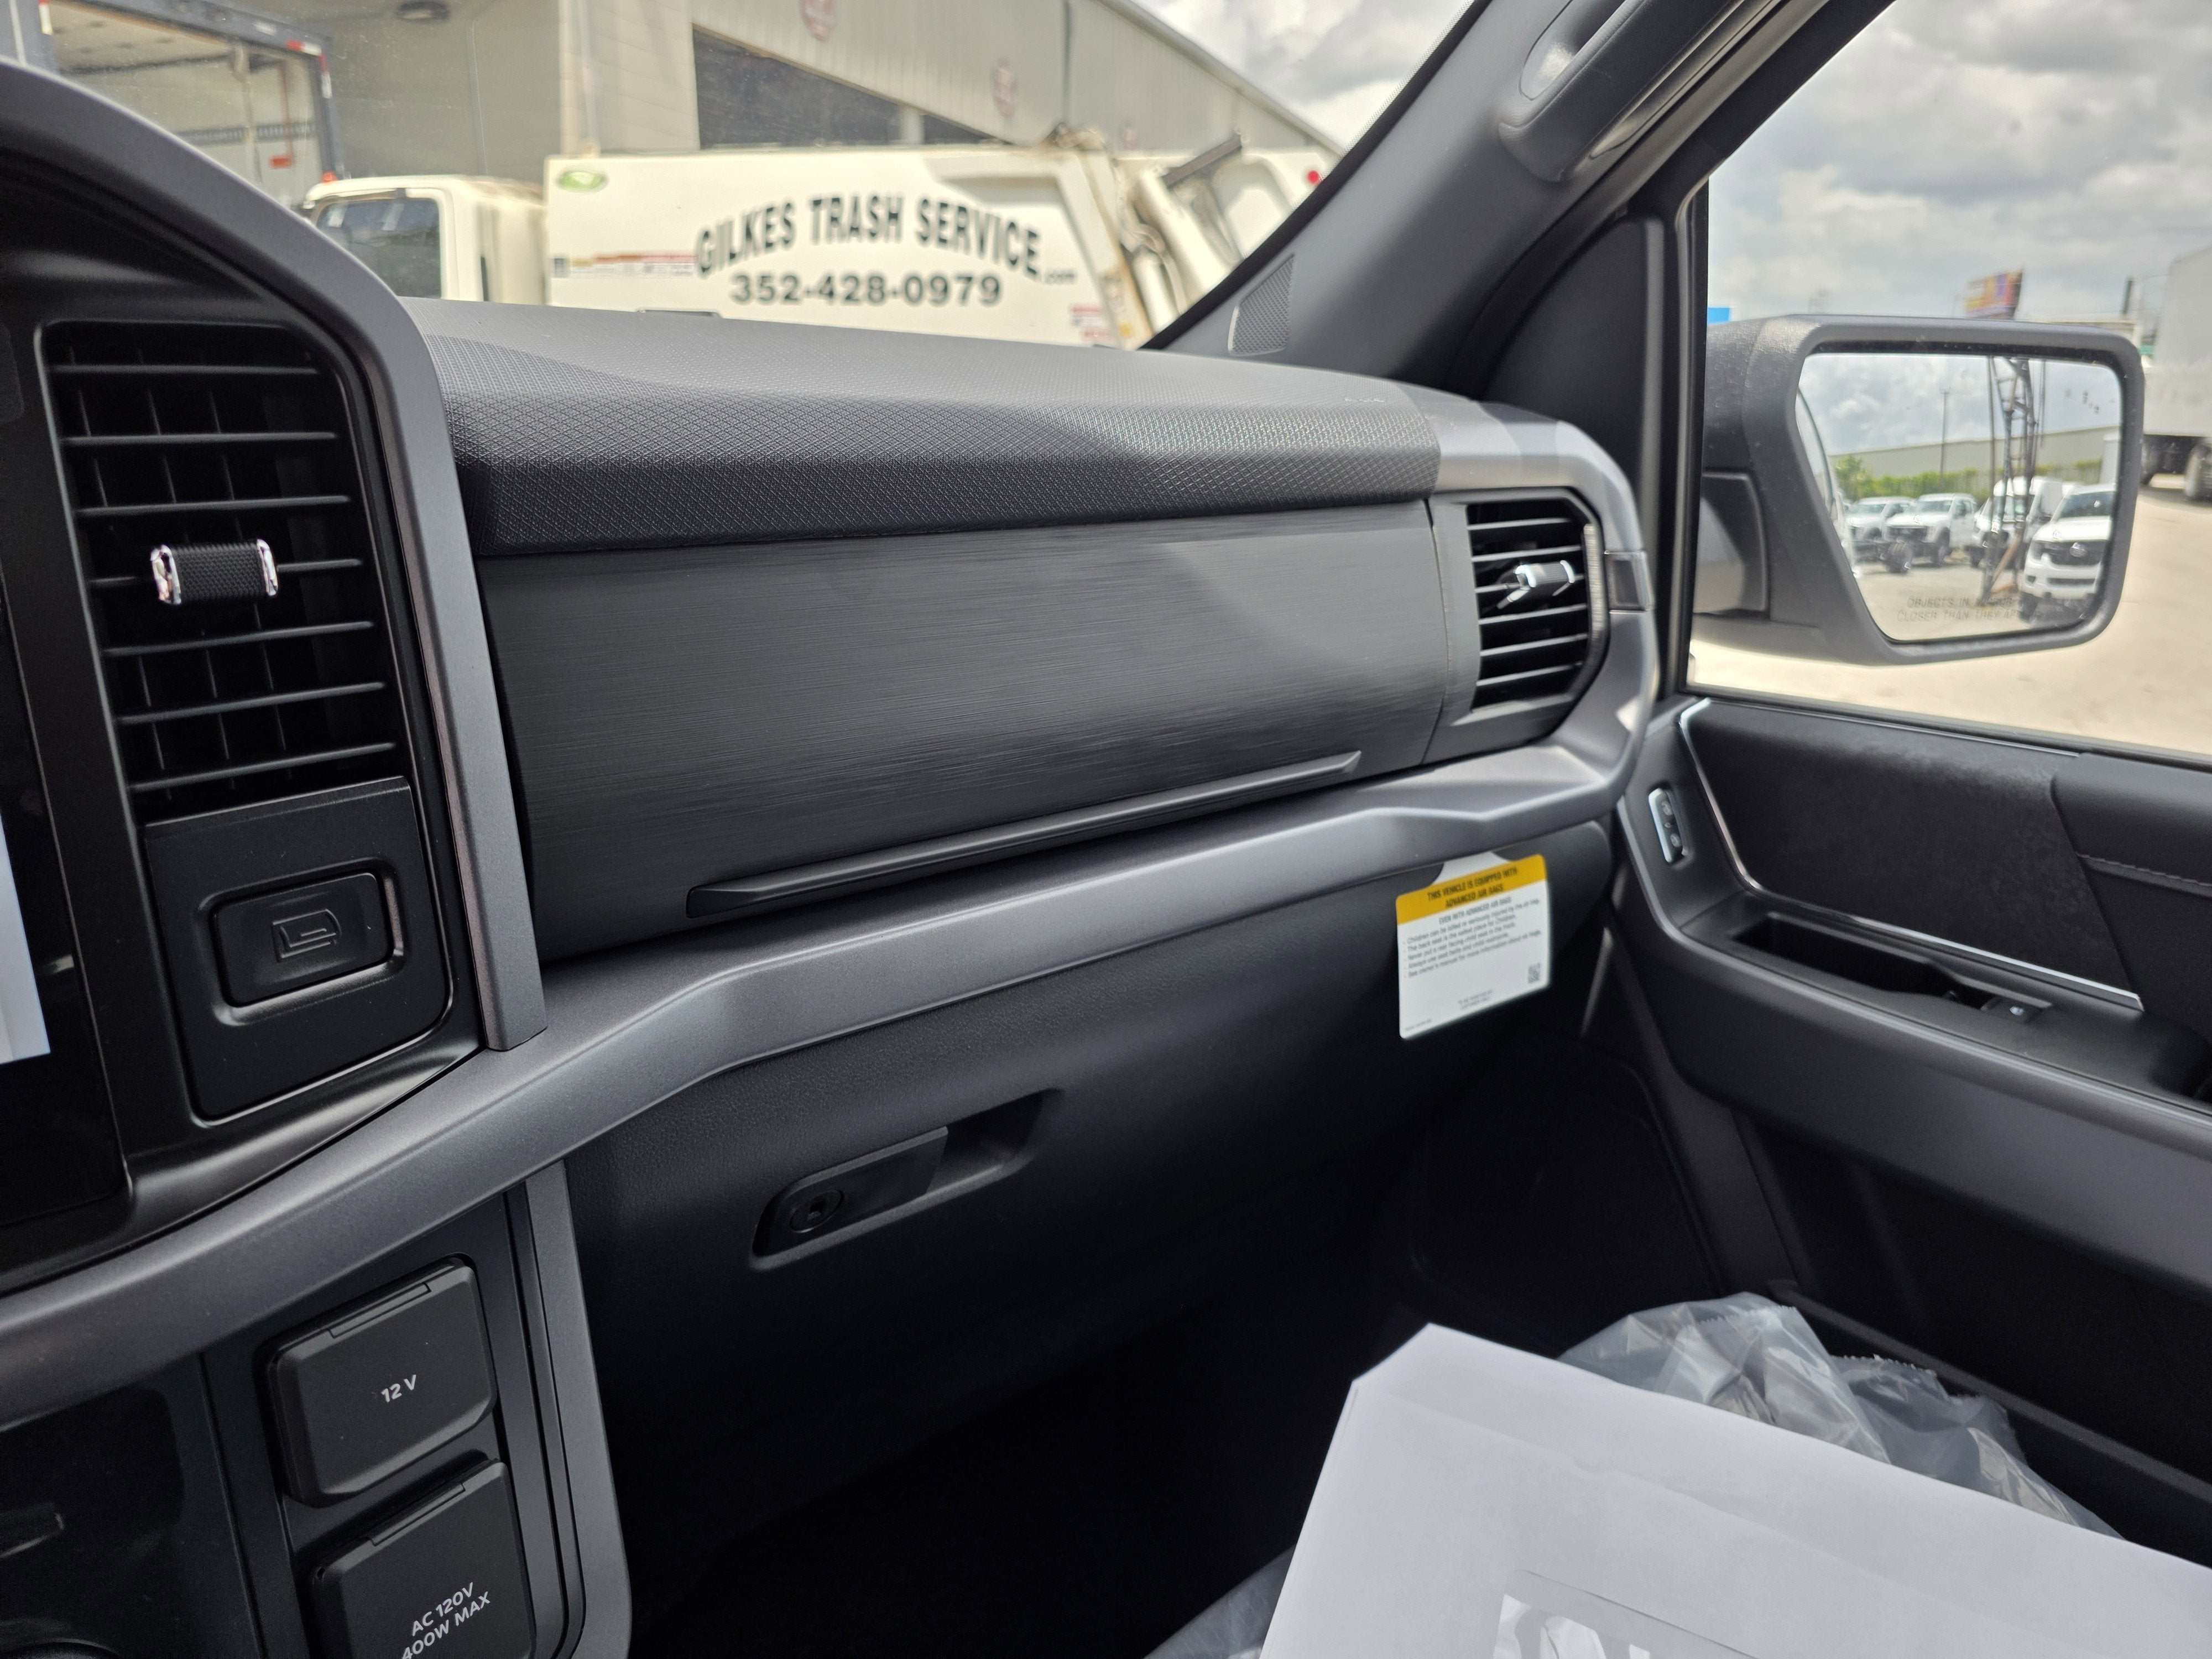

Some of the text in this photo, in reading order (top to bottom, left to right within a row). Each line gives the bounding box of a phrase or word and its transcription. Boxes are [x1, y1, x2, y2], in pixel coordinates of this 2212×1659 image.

[698, 202, 796, 276] GILKES
[808, 194, 903, 243] TRASH
[917, 198, 1040, 279] SERVICE
[731, 274, 1001, 305] 352-428-0979
[382, 1374, 417, 1402] 12 V
[400, 1592, 491, 1659] 400W MAX
[411, 1582, 474, 1636] AC 120V
